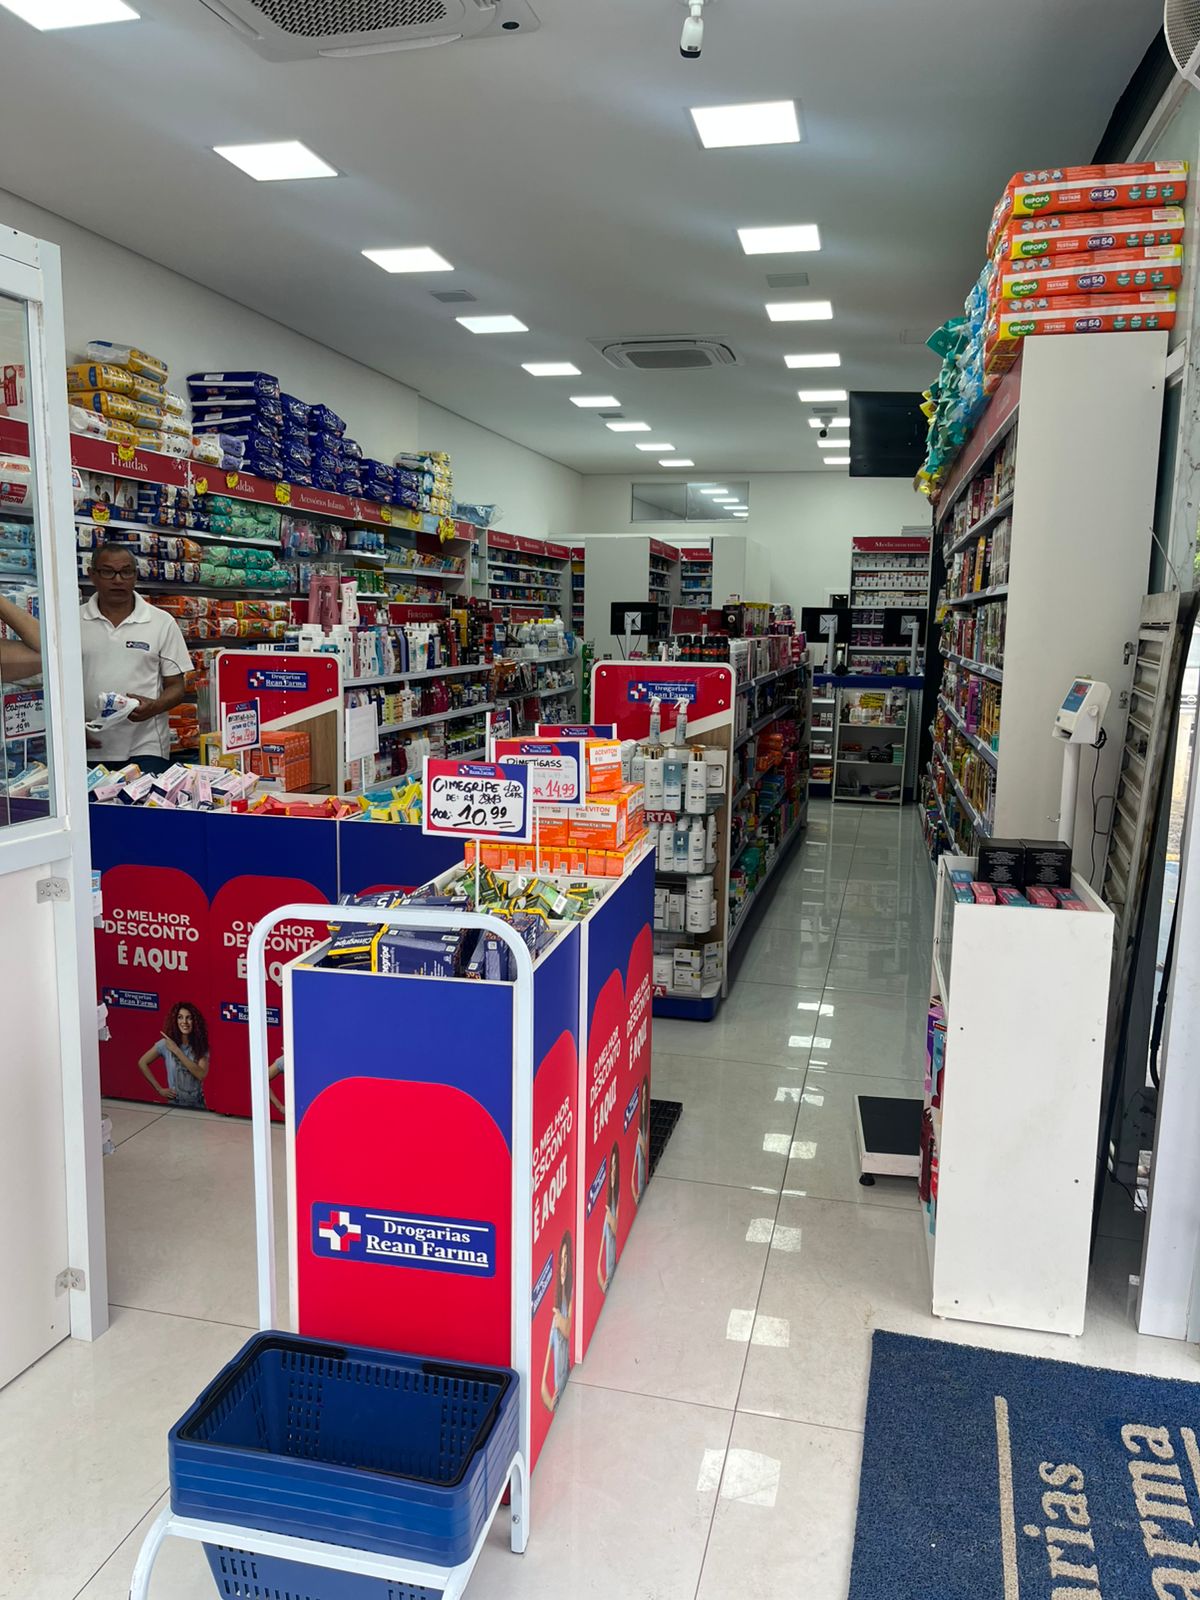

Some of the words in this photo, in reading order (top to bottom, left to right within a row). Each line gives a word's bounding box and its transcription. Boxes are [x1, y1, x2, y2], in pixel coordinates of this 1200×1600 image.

[1024, 195, 1050, 205] HIPOPÓ
[1103, 190, 1115, 198] 54
[1022, 242, 1048, 252] HIPOPÓ
[1101, 237, 1113, 245] 54
[1012, 282, 1038, 292] HIPOPÓ
[1091, 276, 1104, 284] 54
[1010, 323, 1035, 333] HIPOPÓ
[1088, 319, 1100, 327] 54
[113, 908, 124, 919] O
[127, 909, 190, 926] MELHOR
[232, 921, 244, 931] O
[105, 920, 200, 942] DESCONTO
[118, 940, 128, 965] É
[133, 947, 188, 973] AQUI
[626, 984, 651, 1039] DESCONTO
[593, 1061, 598, 1078] O
[598, 1025, 619, 1067] MELHOR
[629, 1037, 634, 1071] É
[589, 1038, 621, 1110] DESCONTO
[593, 1106, 599, 1145] É
[598, 1075, 617, 1135] AQUI
[540, 1096, 569, 1156] MELHOR
[532, 1110, 573, 1193] ESCONTO
[533, 1197, 540, 1244] É
[541, 1154, 567, 1230] AQUI
[384, 1221, 471, 1243] Drogarias
[366, 1234, 417, 1255] Rean
[423, 1242, 488, 1264] Farma
